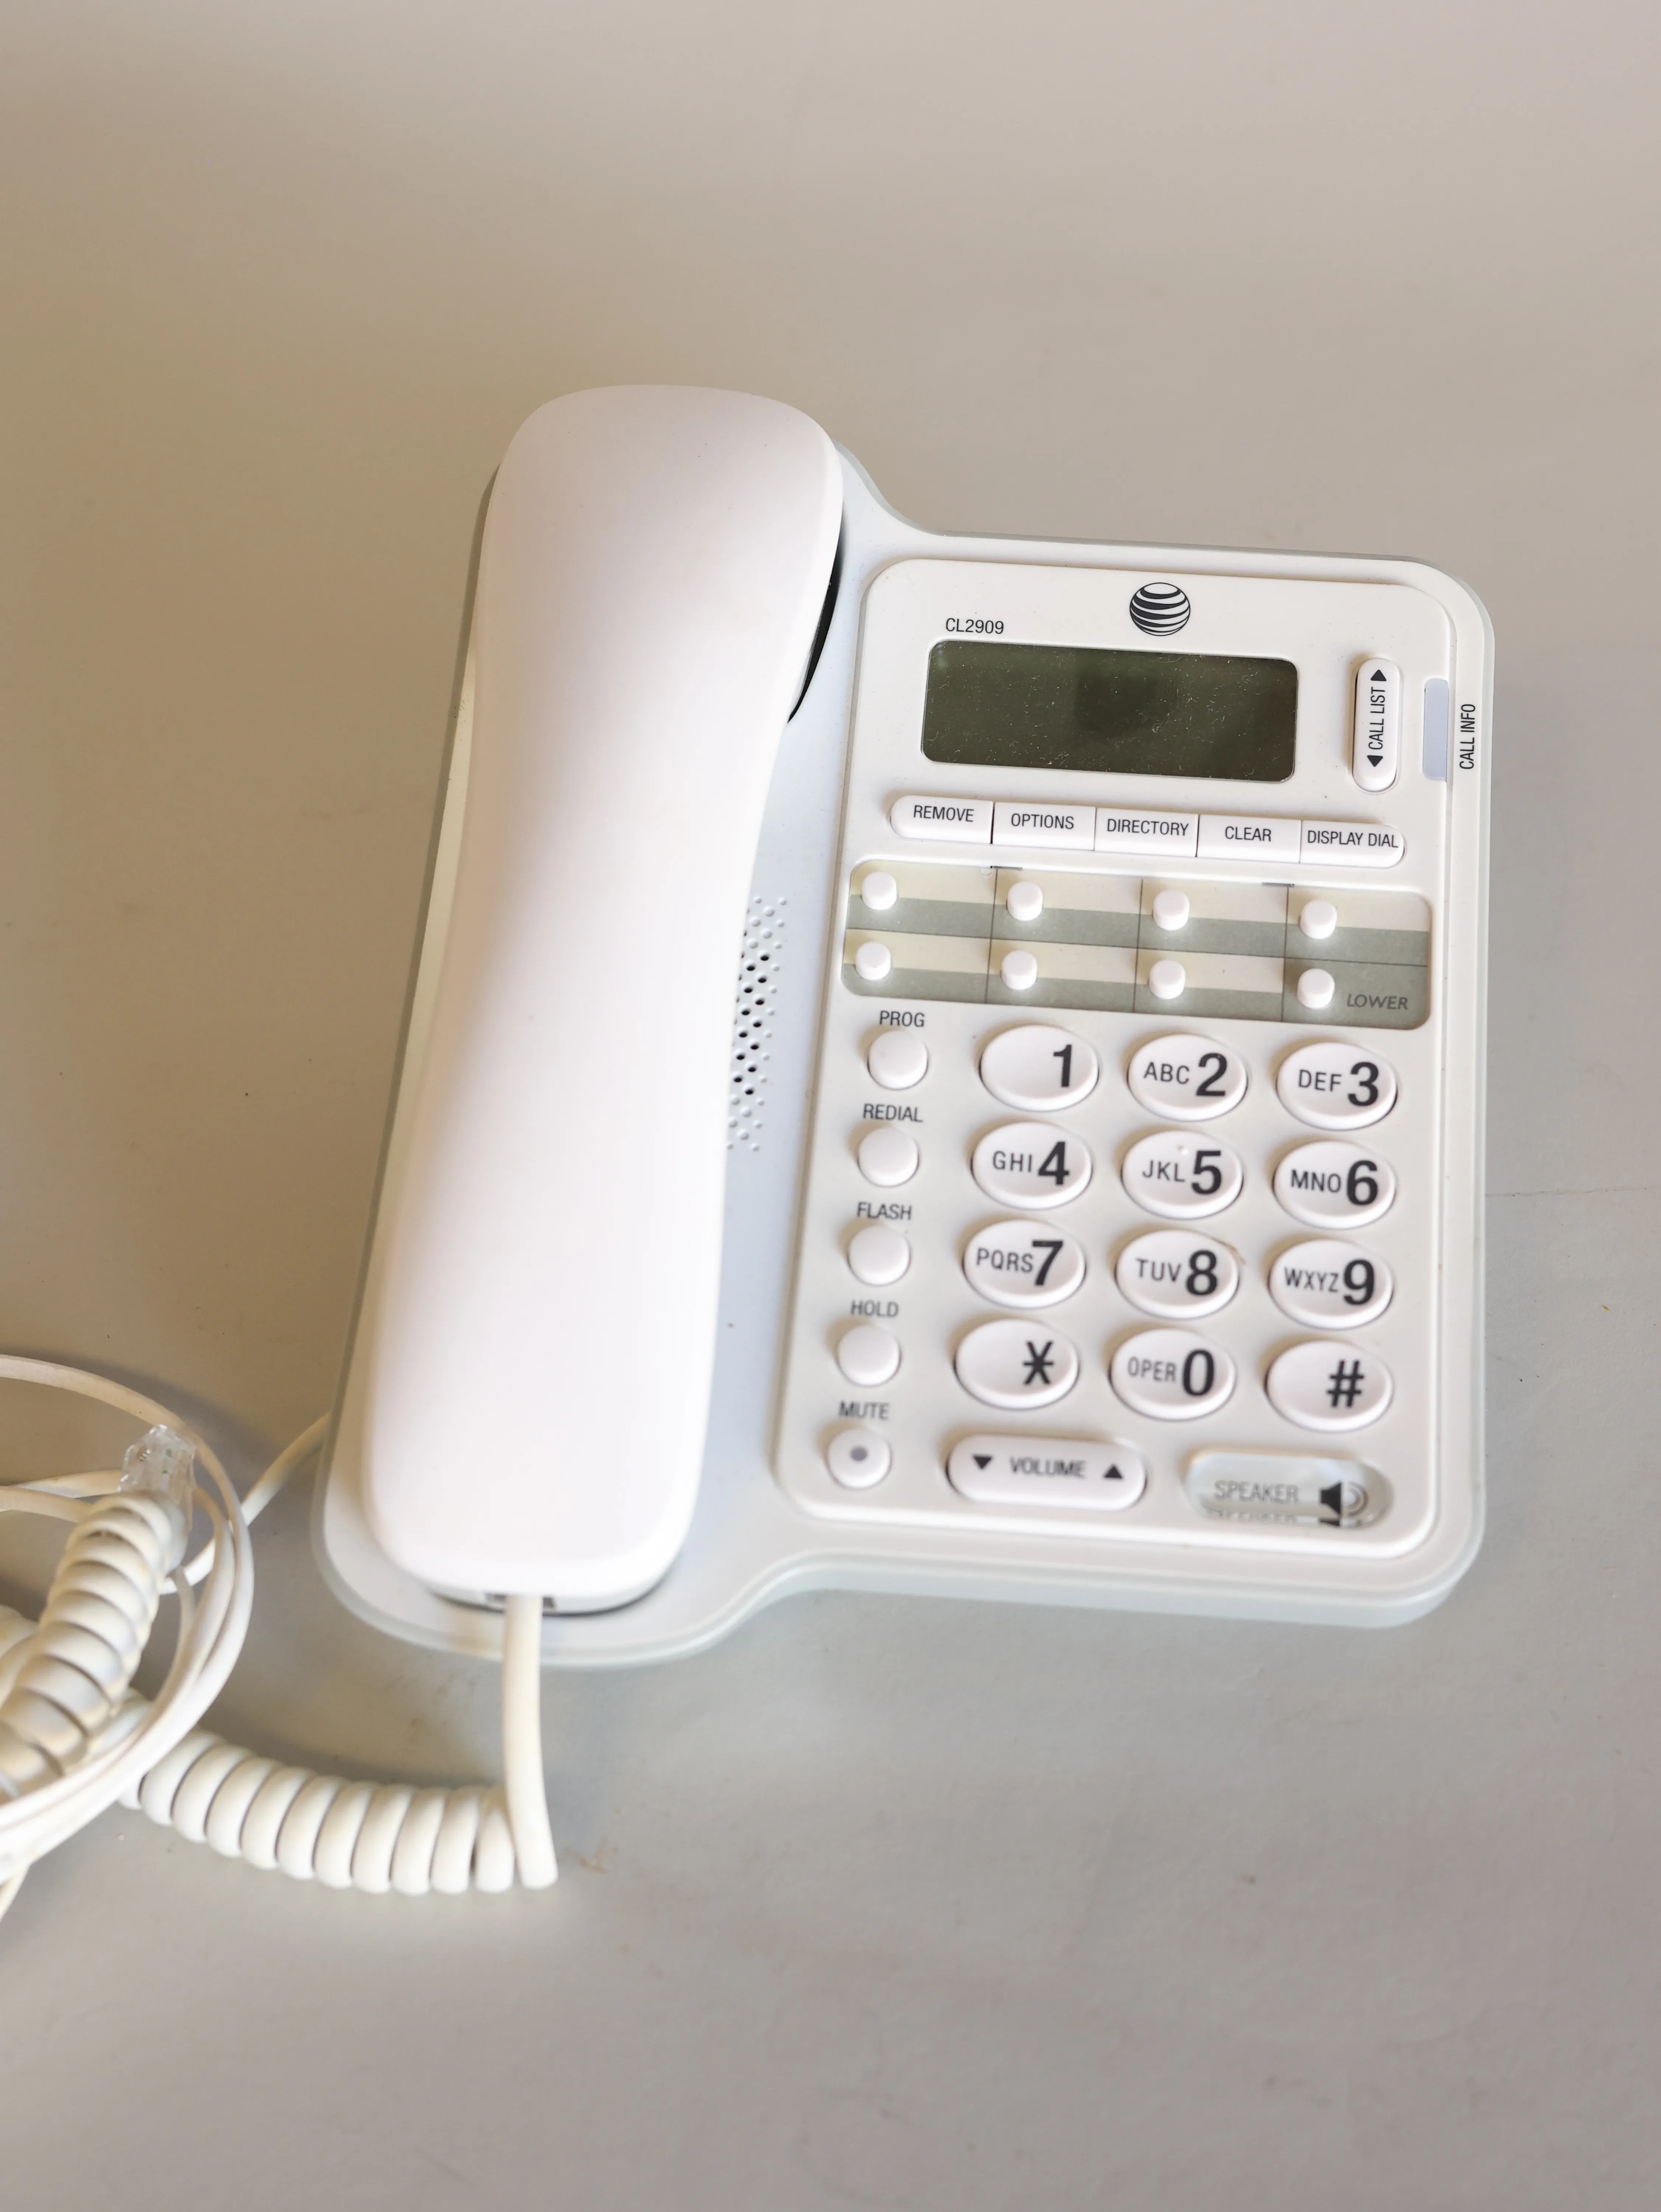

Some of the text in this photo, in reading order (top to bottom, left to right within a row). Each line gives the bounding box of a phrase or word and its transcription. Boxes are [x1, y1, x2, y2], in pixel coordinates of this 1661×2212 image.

[946, 618, 1004, 634] CL2909
[1368, 687, 1385, 749] CALL LIST
[1459, 704, 1476, 769] CALL INFO
[914, 805, 974, 822] REMOVE
[1011, 813, 1074, 829] OPTIONS
[1107, 818, 1189, 836] DIRECTORY
[1225, 826, 1271, 842] CLEAR
[1308, 830, 1399, 848] DISPLAY DIAL
[1347, 994, 1408, 1010] LOWER
[879, 1011, 925, 1027] PROG
[1053, 1044, 1072, 1088] 1
[1144, 1053, 1227, 1097] ABC 2
[1299, 1062, 1379, 1107] DEF 3
[863, 1104, 922, 1122] REDIAL
[993, 1141, 1070, 1186] GHI 4
[1141, 1150, 1222, 1195] JKL 5
[1291, 1160, 1379, 1206] MNO 6
[856, 1202, 911, 1220] FLASH
[977, 1240, 1063, 1286] PQRS 7
[1137, 1250, 1218, 1296] TUV 8
[1285, 1259, 1375, 1306] WXYZ 9
[850, 1300, 899, 1317] HOLD
[1128, 1349, 1215, 1397] OPER 0
[1327, 1360, 1365, 1408] #
[838, 1402, 889, 1419] MUTE
[1011, 1458, 1085, 1478] VOLUME
[1213, 1480, 1300, 1504] SPEAKER
